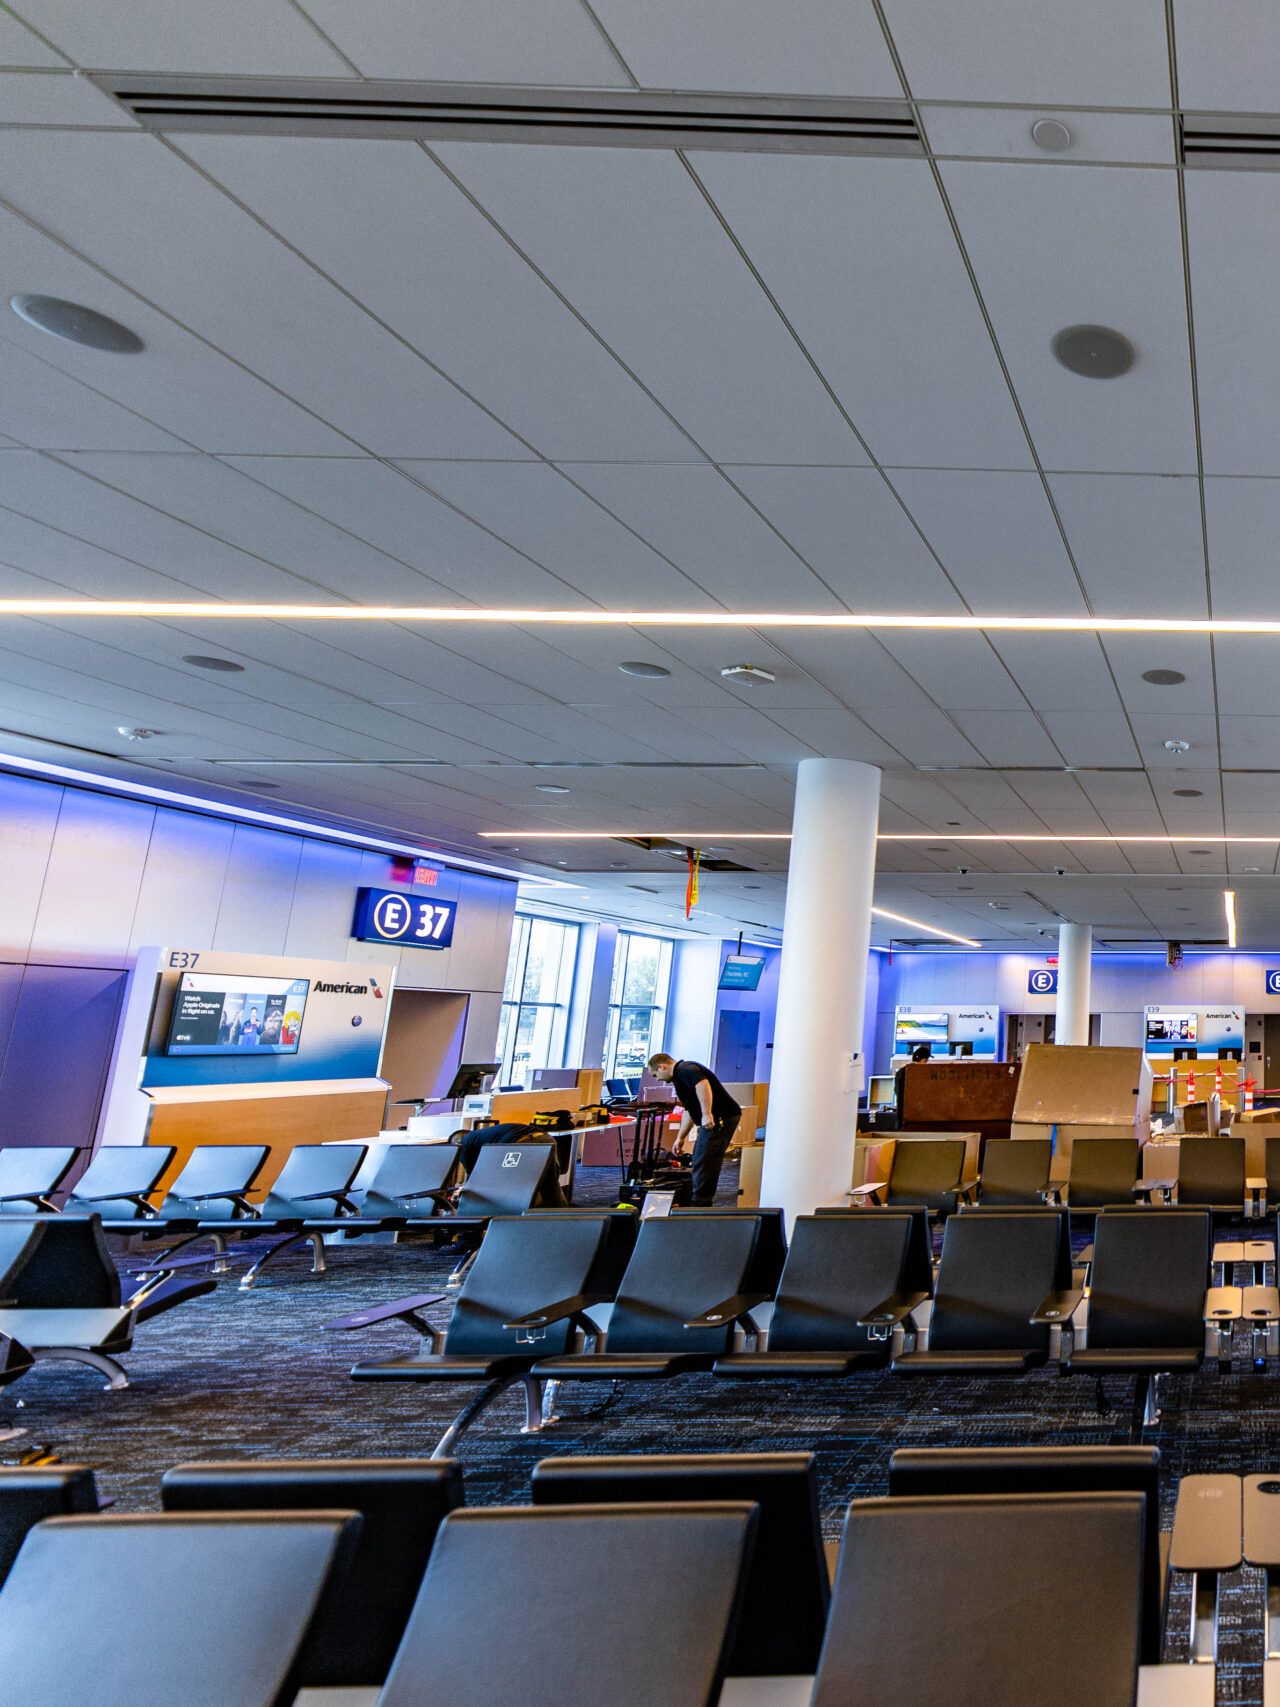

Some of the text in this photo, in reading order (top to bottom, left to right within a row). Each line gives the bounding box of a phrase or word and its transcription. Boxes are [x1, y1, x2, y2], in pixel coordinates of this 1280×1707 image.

[384, 902, 450, 939] E 37
[169, 951, 200, 969] E37
[313, 980, 368, 995] American
[1037, 975, 1047, 987] E
[183, 1001, 221, 1010] Apple Originals
